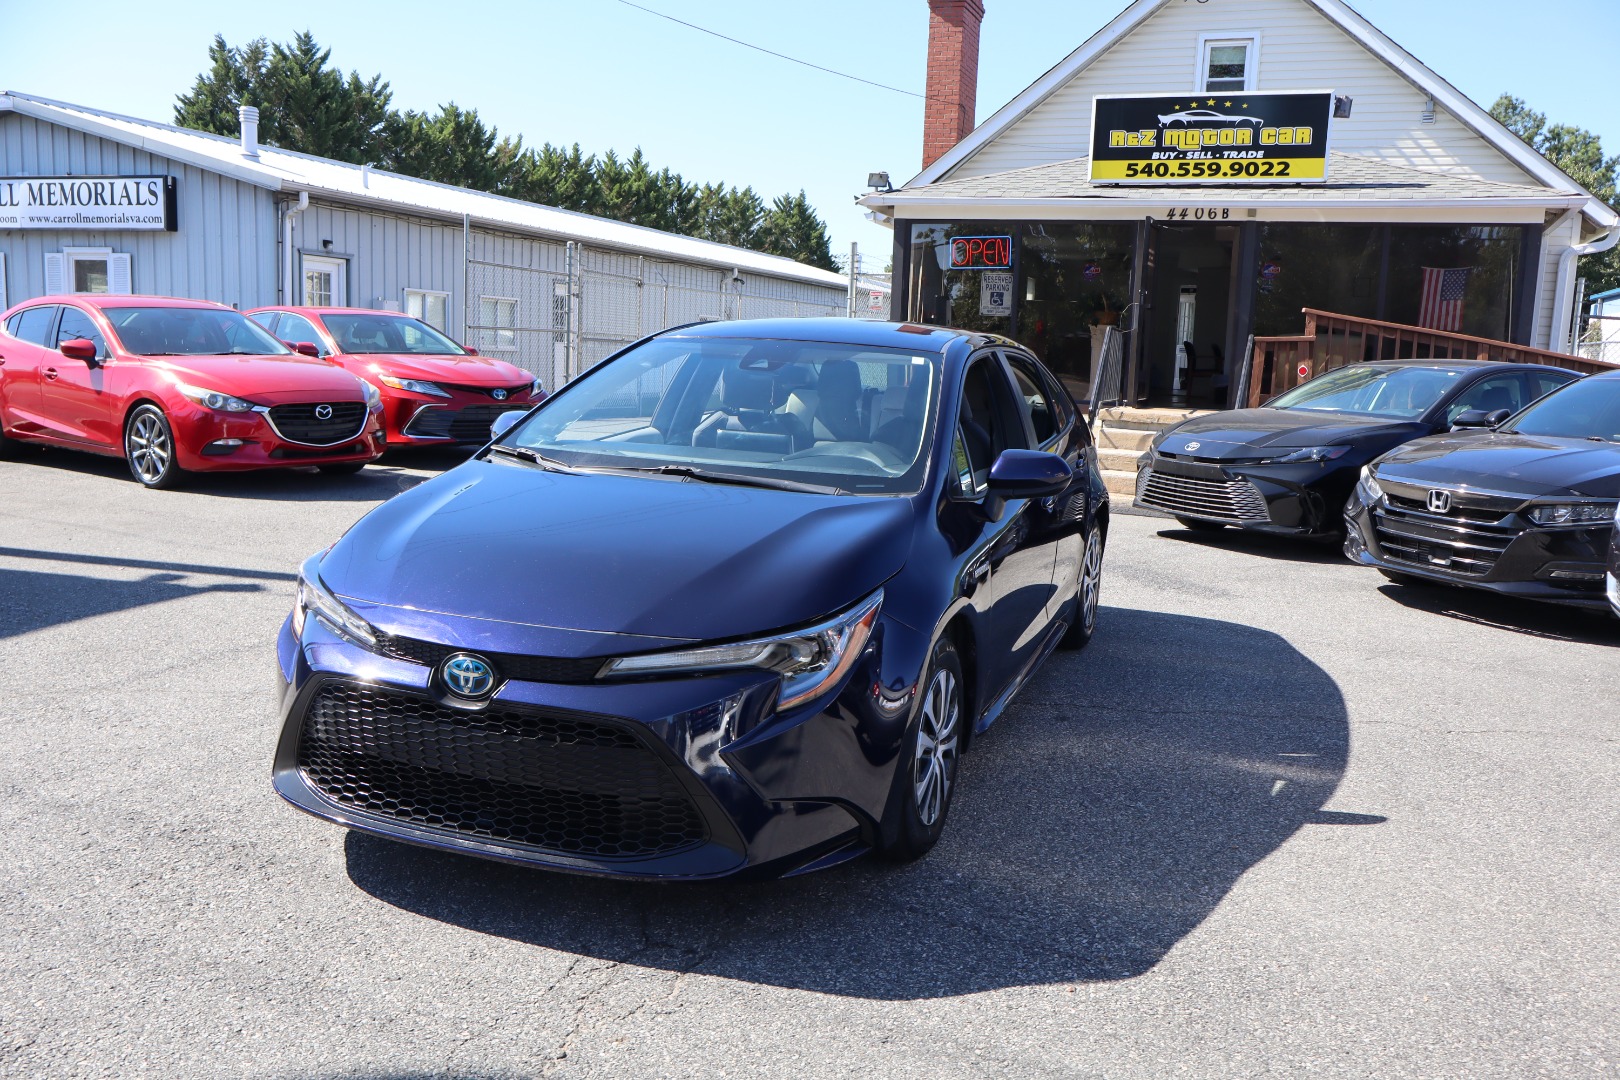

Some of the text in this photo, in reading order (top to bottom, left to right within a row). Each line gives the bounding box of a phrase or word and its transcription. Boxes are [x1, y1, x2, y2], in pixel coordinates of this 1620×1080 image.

[1109, 129, 1157, 147] R&Z
[1151, 150, 1265, 160] BUY SELL TRADE
[1125, 161, 1291, 177] 540.559.9022
[27, 181, 159, 206] MEMORIALS
[29, 212, 163, 224] www.carrollmemorialsva.com
[952, 238, 1010, 266] OPEN
[983, 275, 1013, 284] RESERVED
[985, 283, 1010, 291] PARKING
